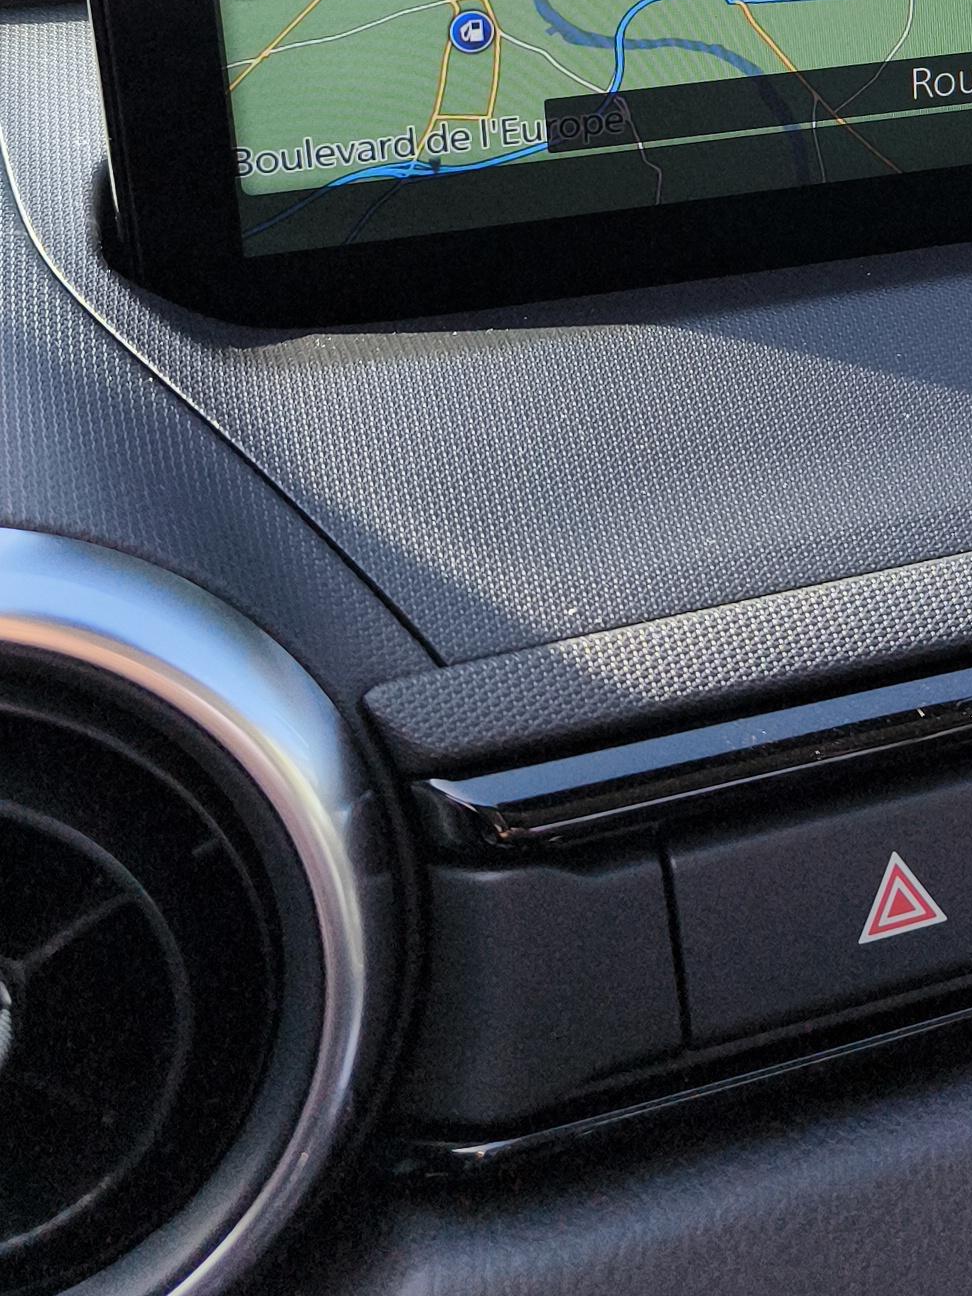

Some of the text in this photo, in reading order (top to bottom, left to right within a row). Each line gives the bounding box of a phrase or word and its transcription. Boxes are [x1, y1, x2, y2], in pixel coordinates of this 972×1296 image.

[235, 109, 625, 177] Boulevard de l'Europe
